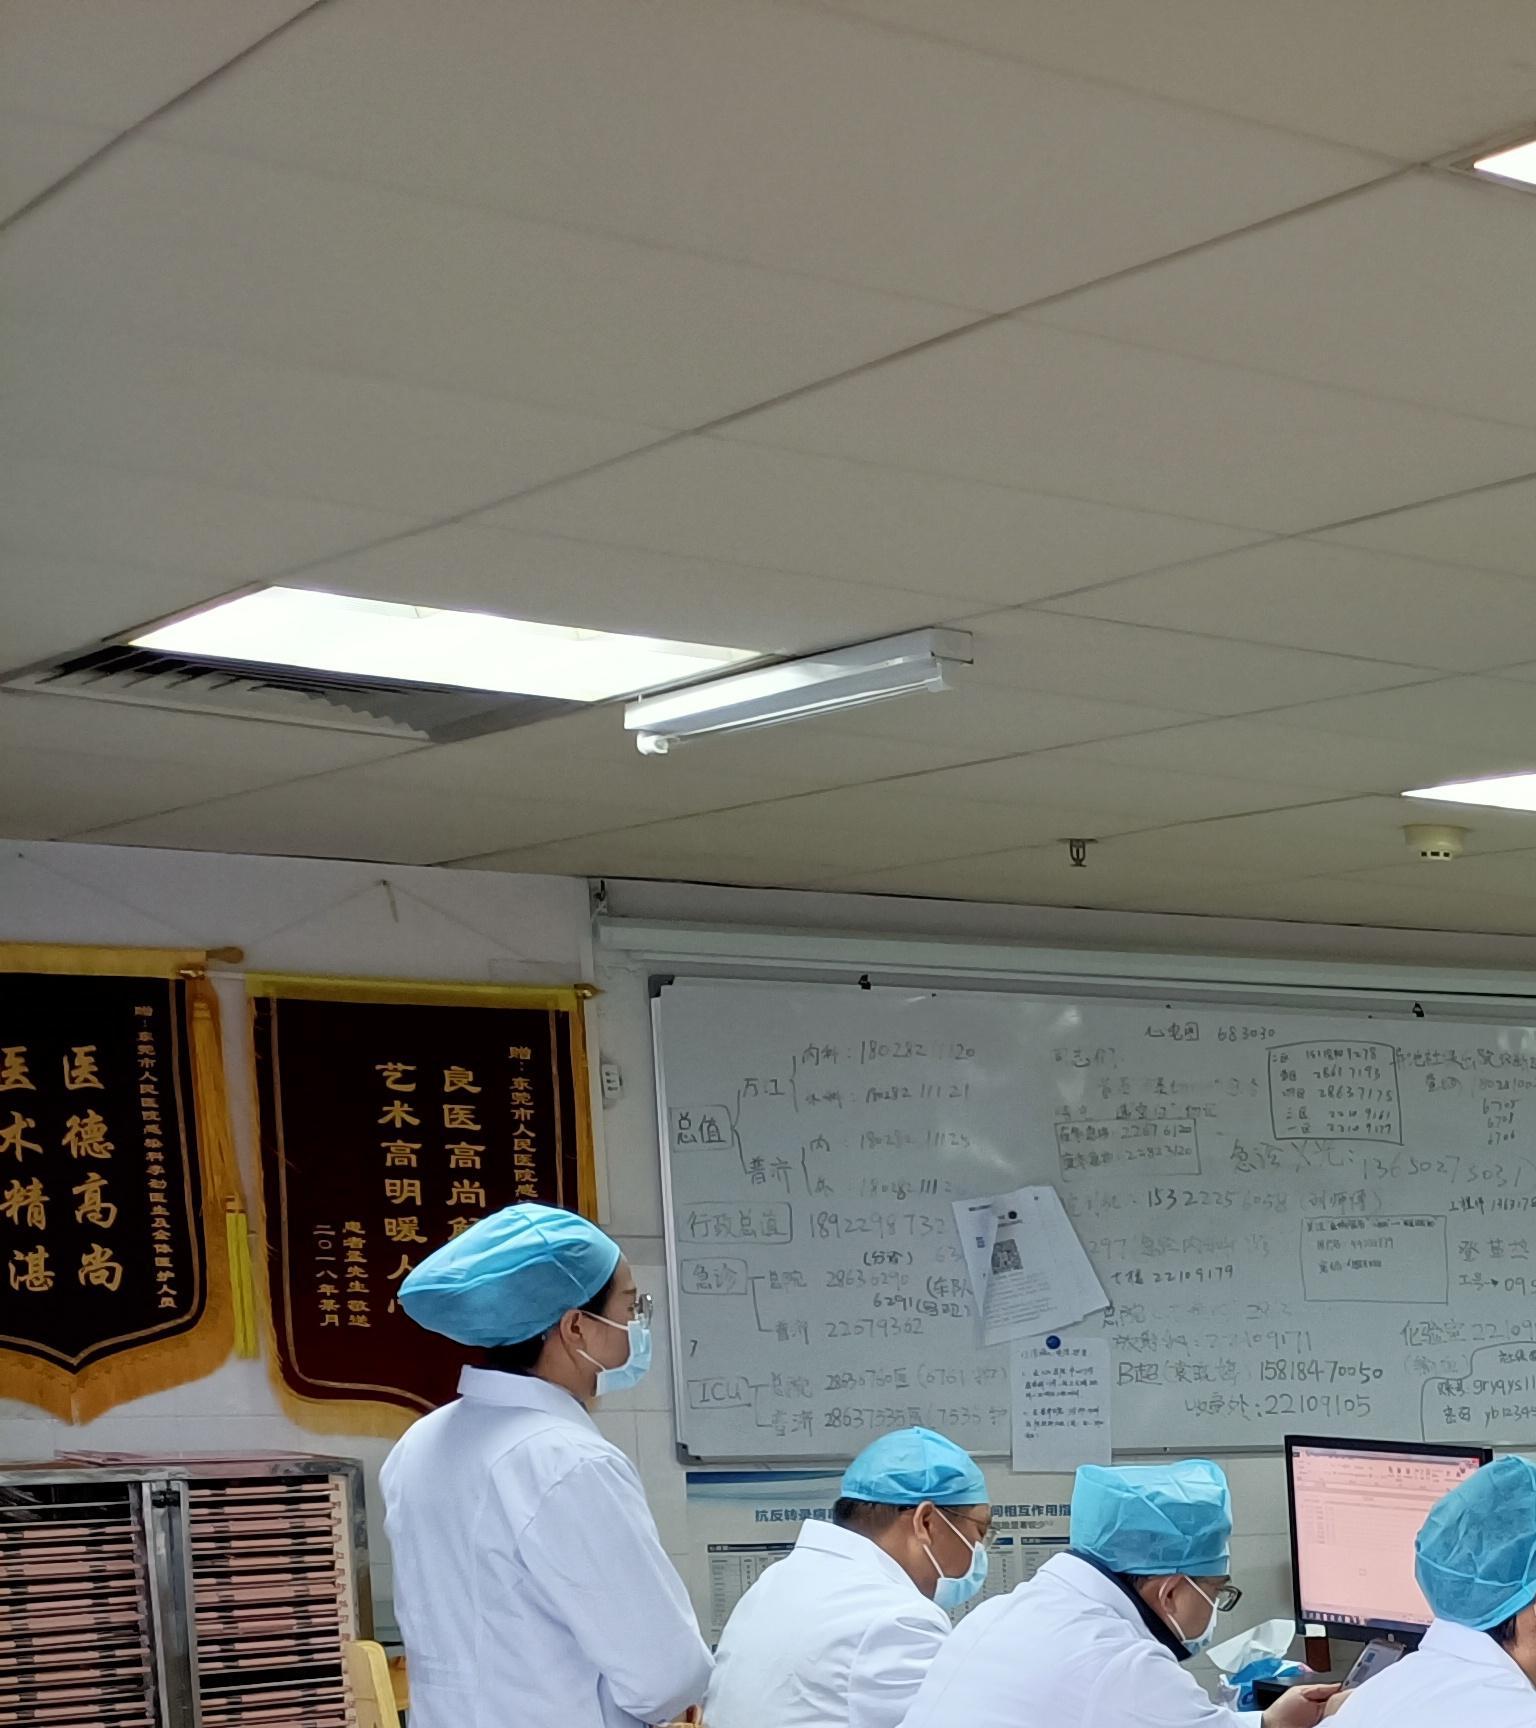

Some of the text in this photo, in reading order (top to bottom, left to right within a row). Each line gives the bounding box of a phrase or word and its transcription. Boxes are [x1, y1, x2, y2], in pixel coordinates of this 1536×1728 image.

[0, 1045, 56, 1292] 医术精湛
[61, 1045, 124, 1292] 医德高尚
[375, 1062, 428, 1314] 艺术高明暖人
[509, 1046, 540, 1201] 赠:东莞市人民医院感
[676, 1111, 726, 1145] 总值
[699, 1380, 742, 1403] ICU
